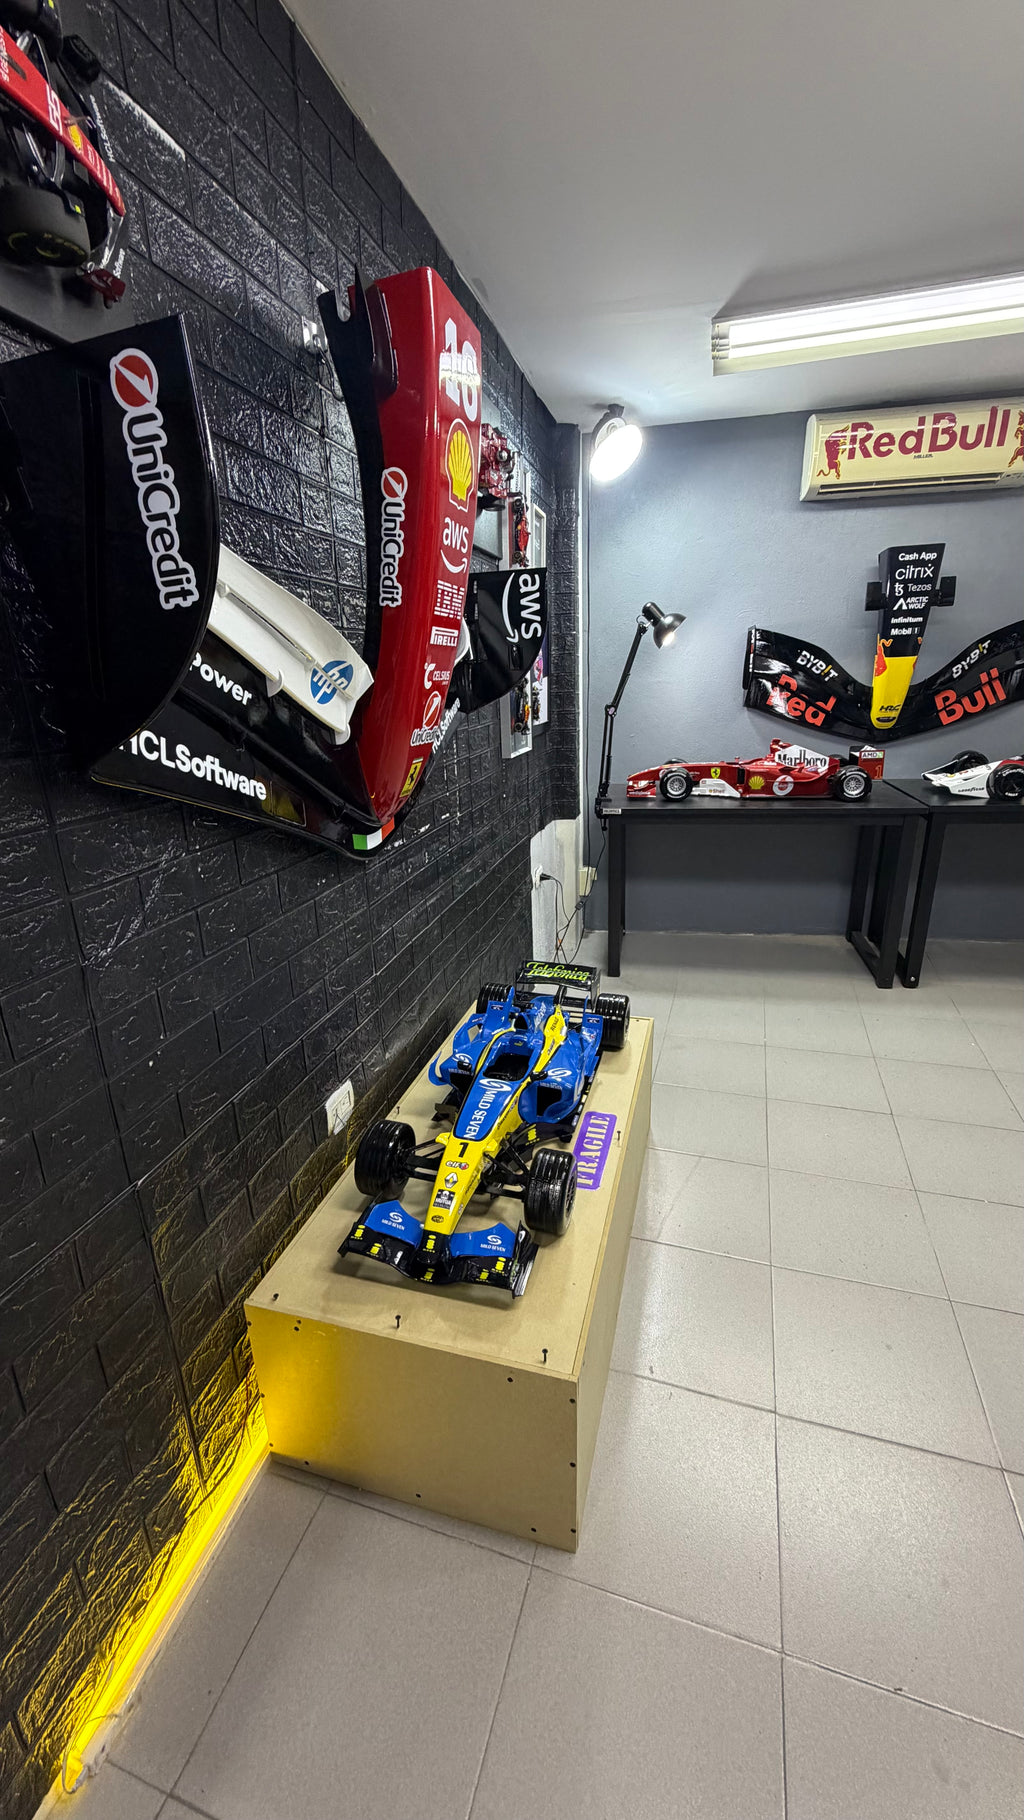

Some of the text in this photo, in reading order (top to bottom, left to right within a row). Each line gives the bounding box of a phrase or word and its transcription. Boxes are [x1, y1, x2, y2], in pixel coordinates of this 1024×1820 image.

[123, 403, 200, 610] UniCredit
[379, 498, 406, 608] UniCredit
[442, 517, 469, 554] aws
[895, 564, 934, 580] citrix
[898, 552, 937, 561] Cash App
[434, 580, 465, 620] IBM
[519, 573, 542, 639] aws
[907, 584, 932, 592] Tezos
[430, 626, 459, 647] PIRELLI
[432, 670, 451, 681] CELSIUS
[766, 674, 836, 726] Red
[934, 668, 1006, 726] Bull
[777, 750, 827, 767] Marlboro
[463, 1090, 498, 1139] MILD SEVEN
[458, 1142, 469, 1158] 1
[577, 1115, 610, 1186] FRAGILE
